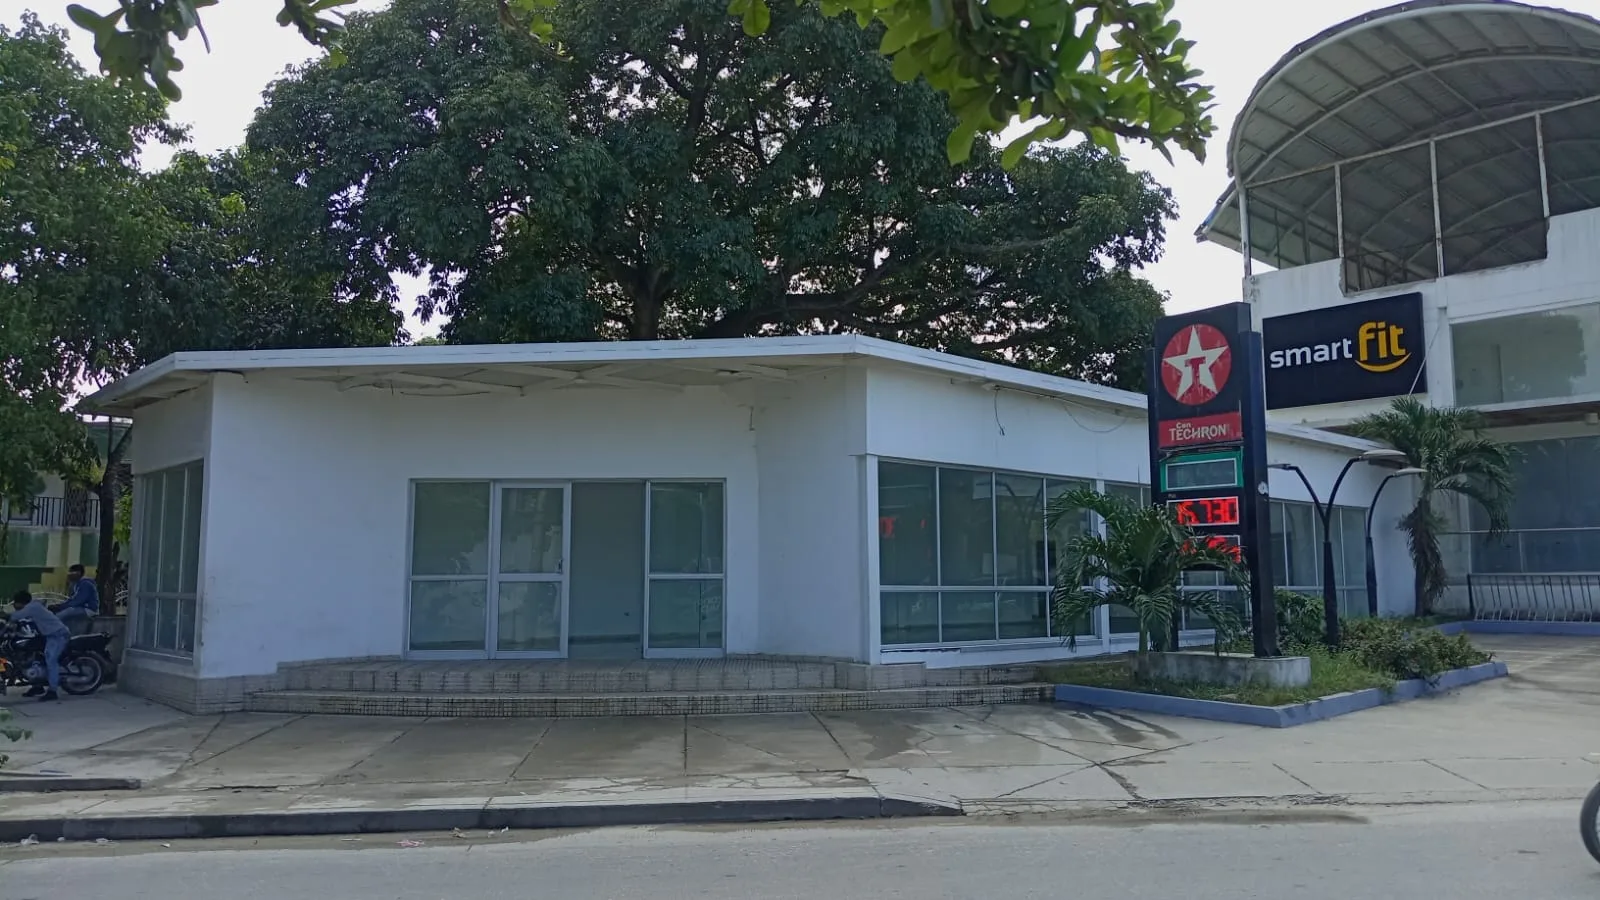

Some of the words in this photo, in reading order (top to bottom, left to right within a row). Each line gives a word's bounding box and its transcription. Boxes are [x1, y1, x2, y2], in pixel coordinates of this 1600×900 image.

[1269, 338, 1353, 369] smart
[1358, 321, 1406, 361] fit
[1168, 424, 1227, 441] TECHRON
